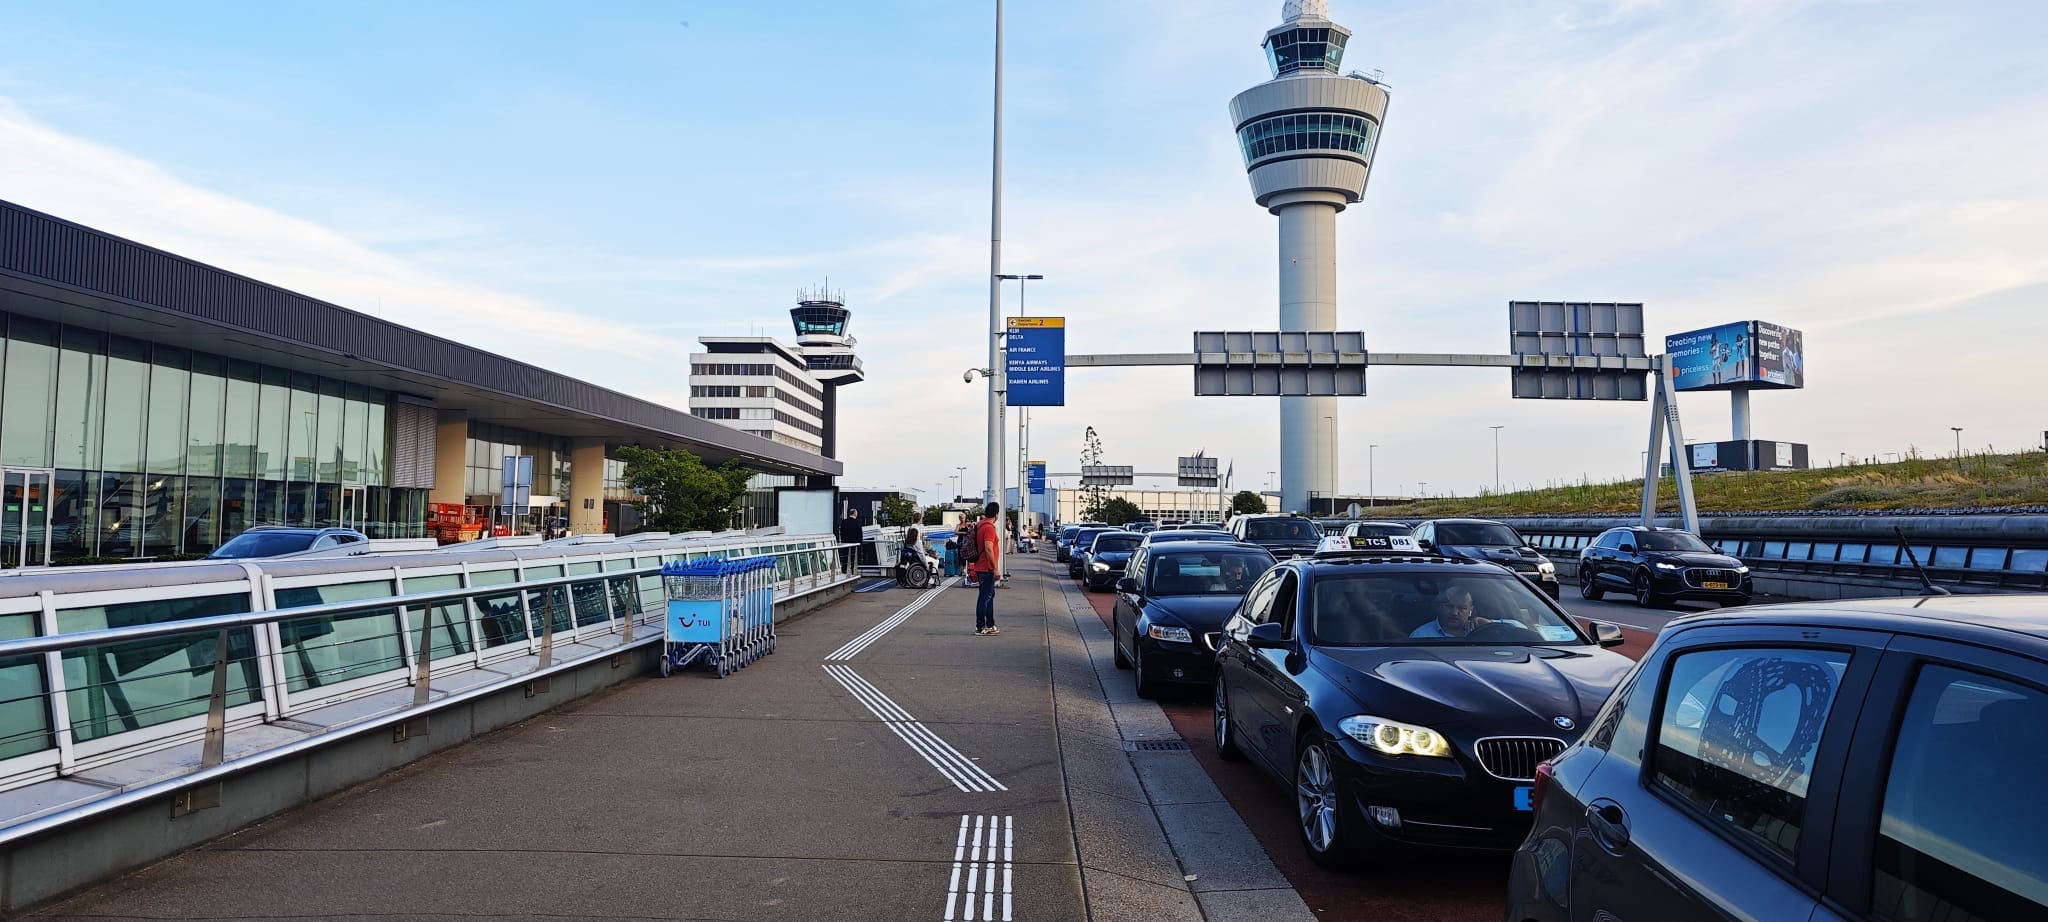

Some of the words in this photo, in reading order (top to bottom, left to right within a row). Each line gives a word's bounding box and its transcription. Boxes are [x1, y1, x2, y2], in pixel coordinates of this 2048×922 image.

[1667, 335, 1697, 348] Creating
[1697, 333, 1713, 343] new
[1759, 338, 1767, 347] new
[1767, 339, 1781, 349] paths
[1681, 365, 1709, 376] priceless
[1366, 538, 1387, 546] TCS
[1392, 538, 1410, 546] 081
